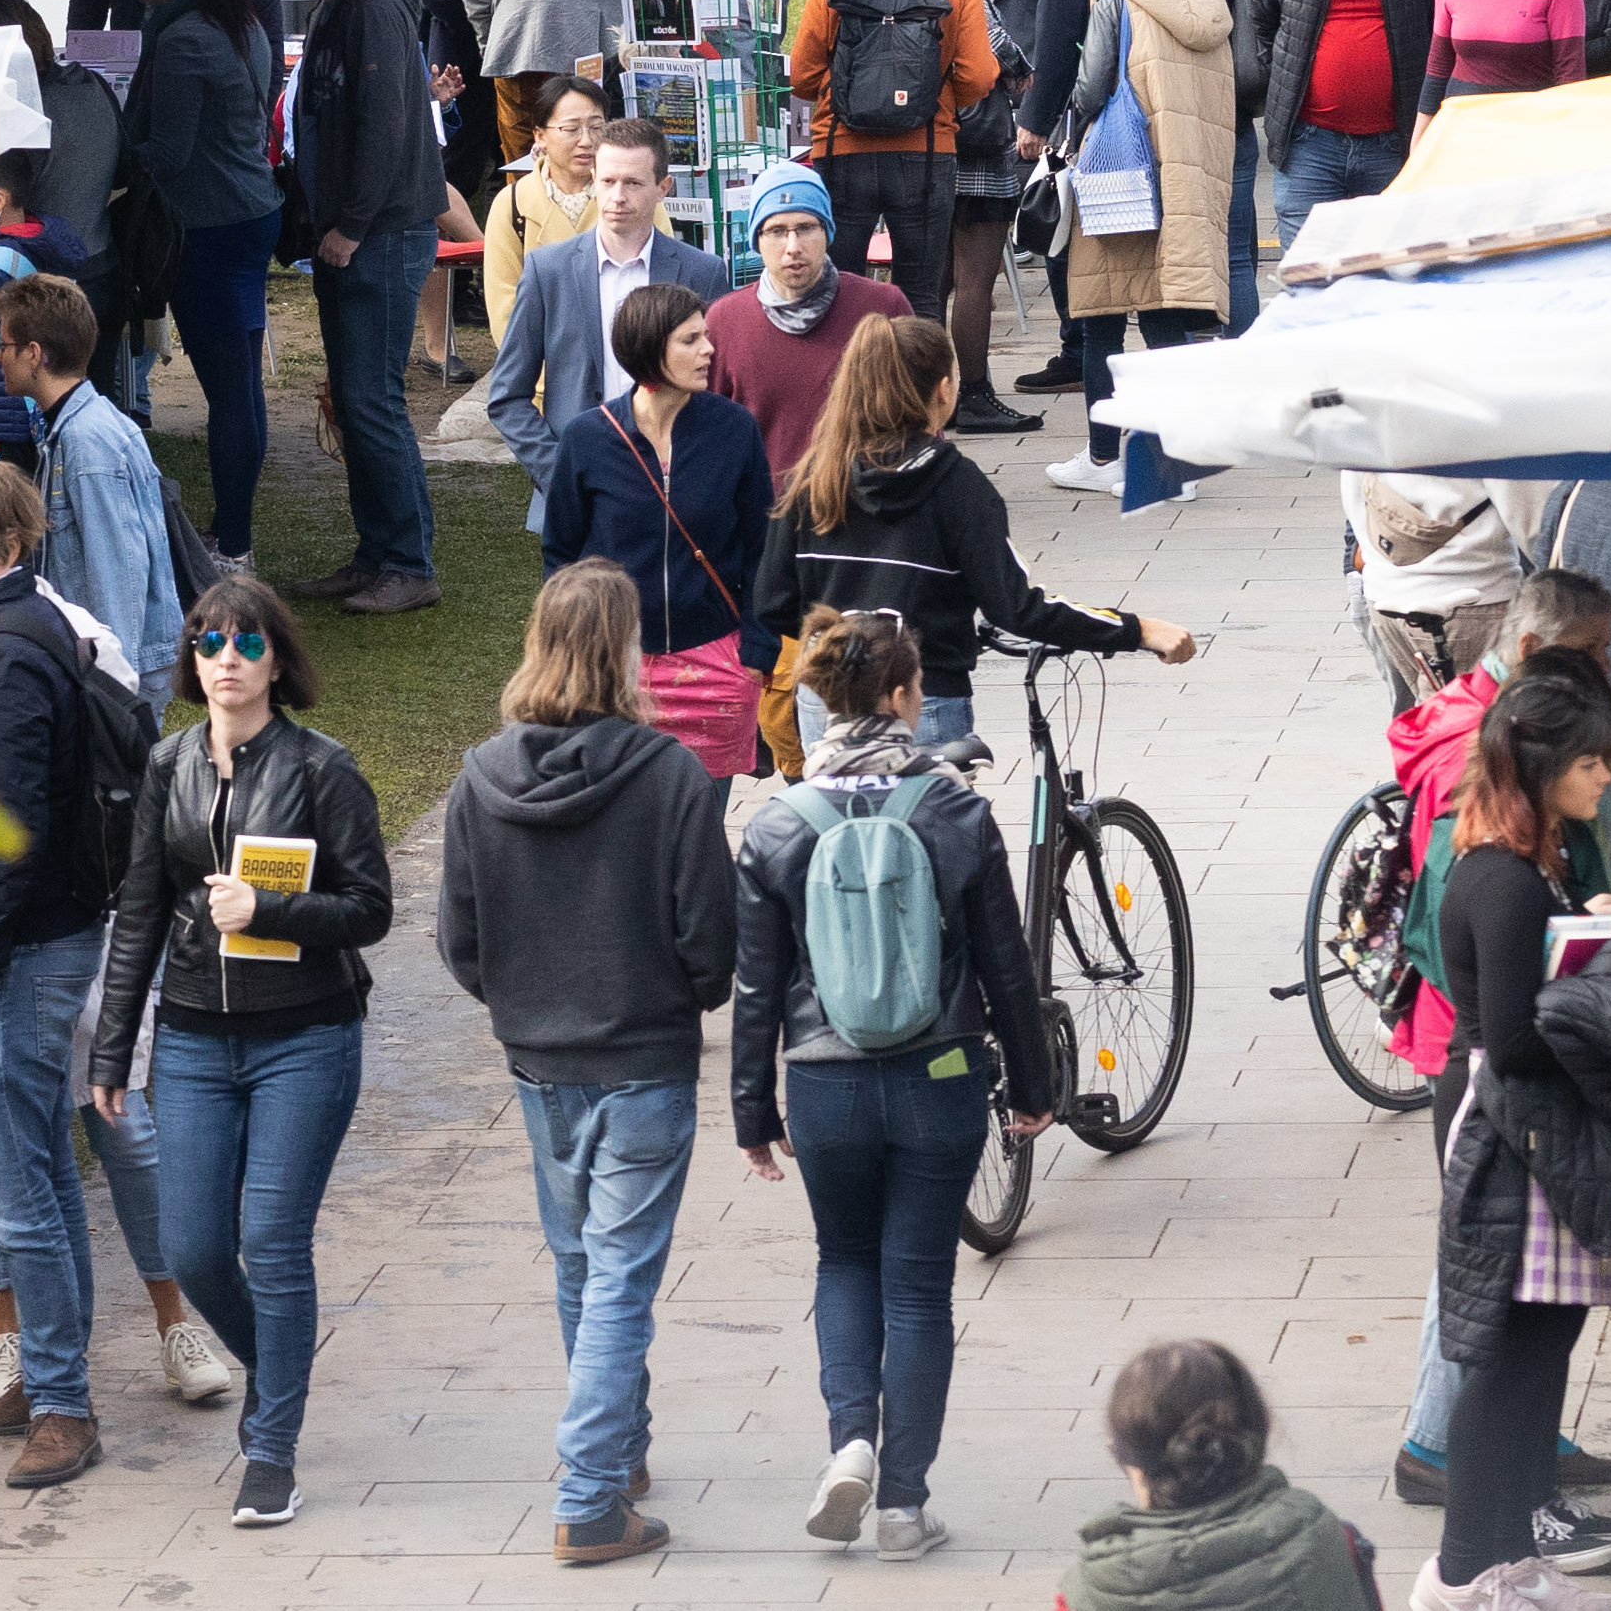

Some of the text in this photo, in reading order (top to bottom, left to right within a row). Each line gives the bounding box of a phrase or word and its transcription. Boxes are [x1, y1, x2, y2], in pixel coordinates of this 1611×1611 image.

[633, 61, 695, 72] IRODALMI MAGAZIN
[682, 201, 704, 214] NAPLÓ
[242, 857, 306, 880] BARABÁSI
